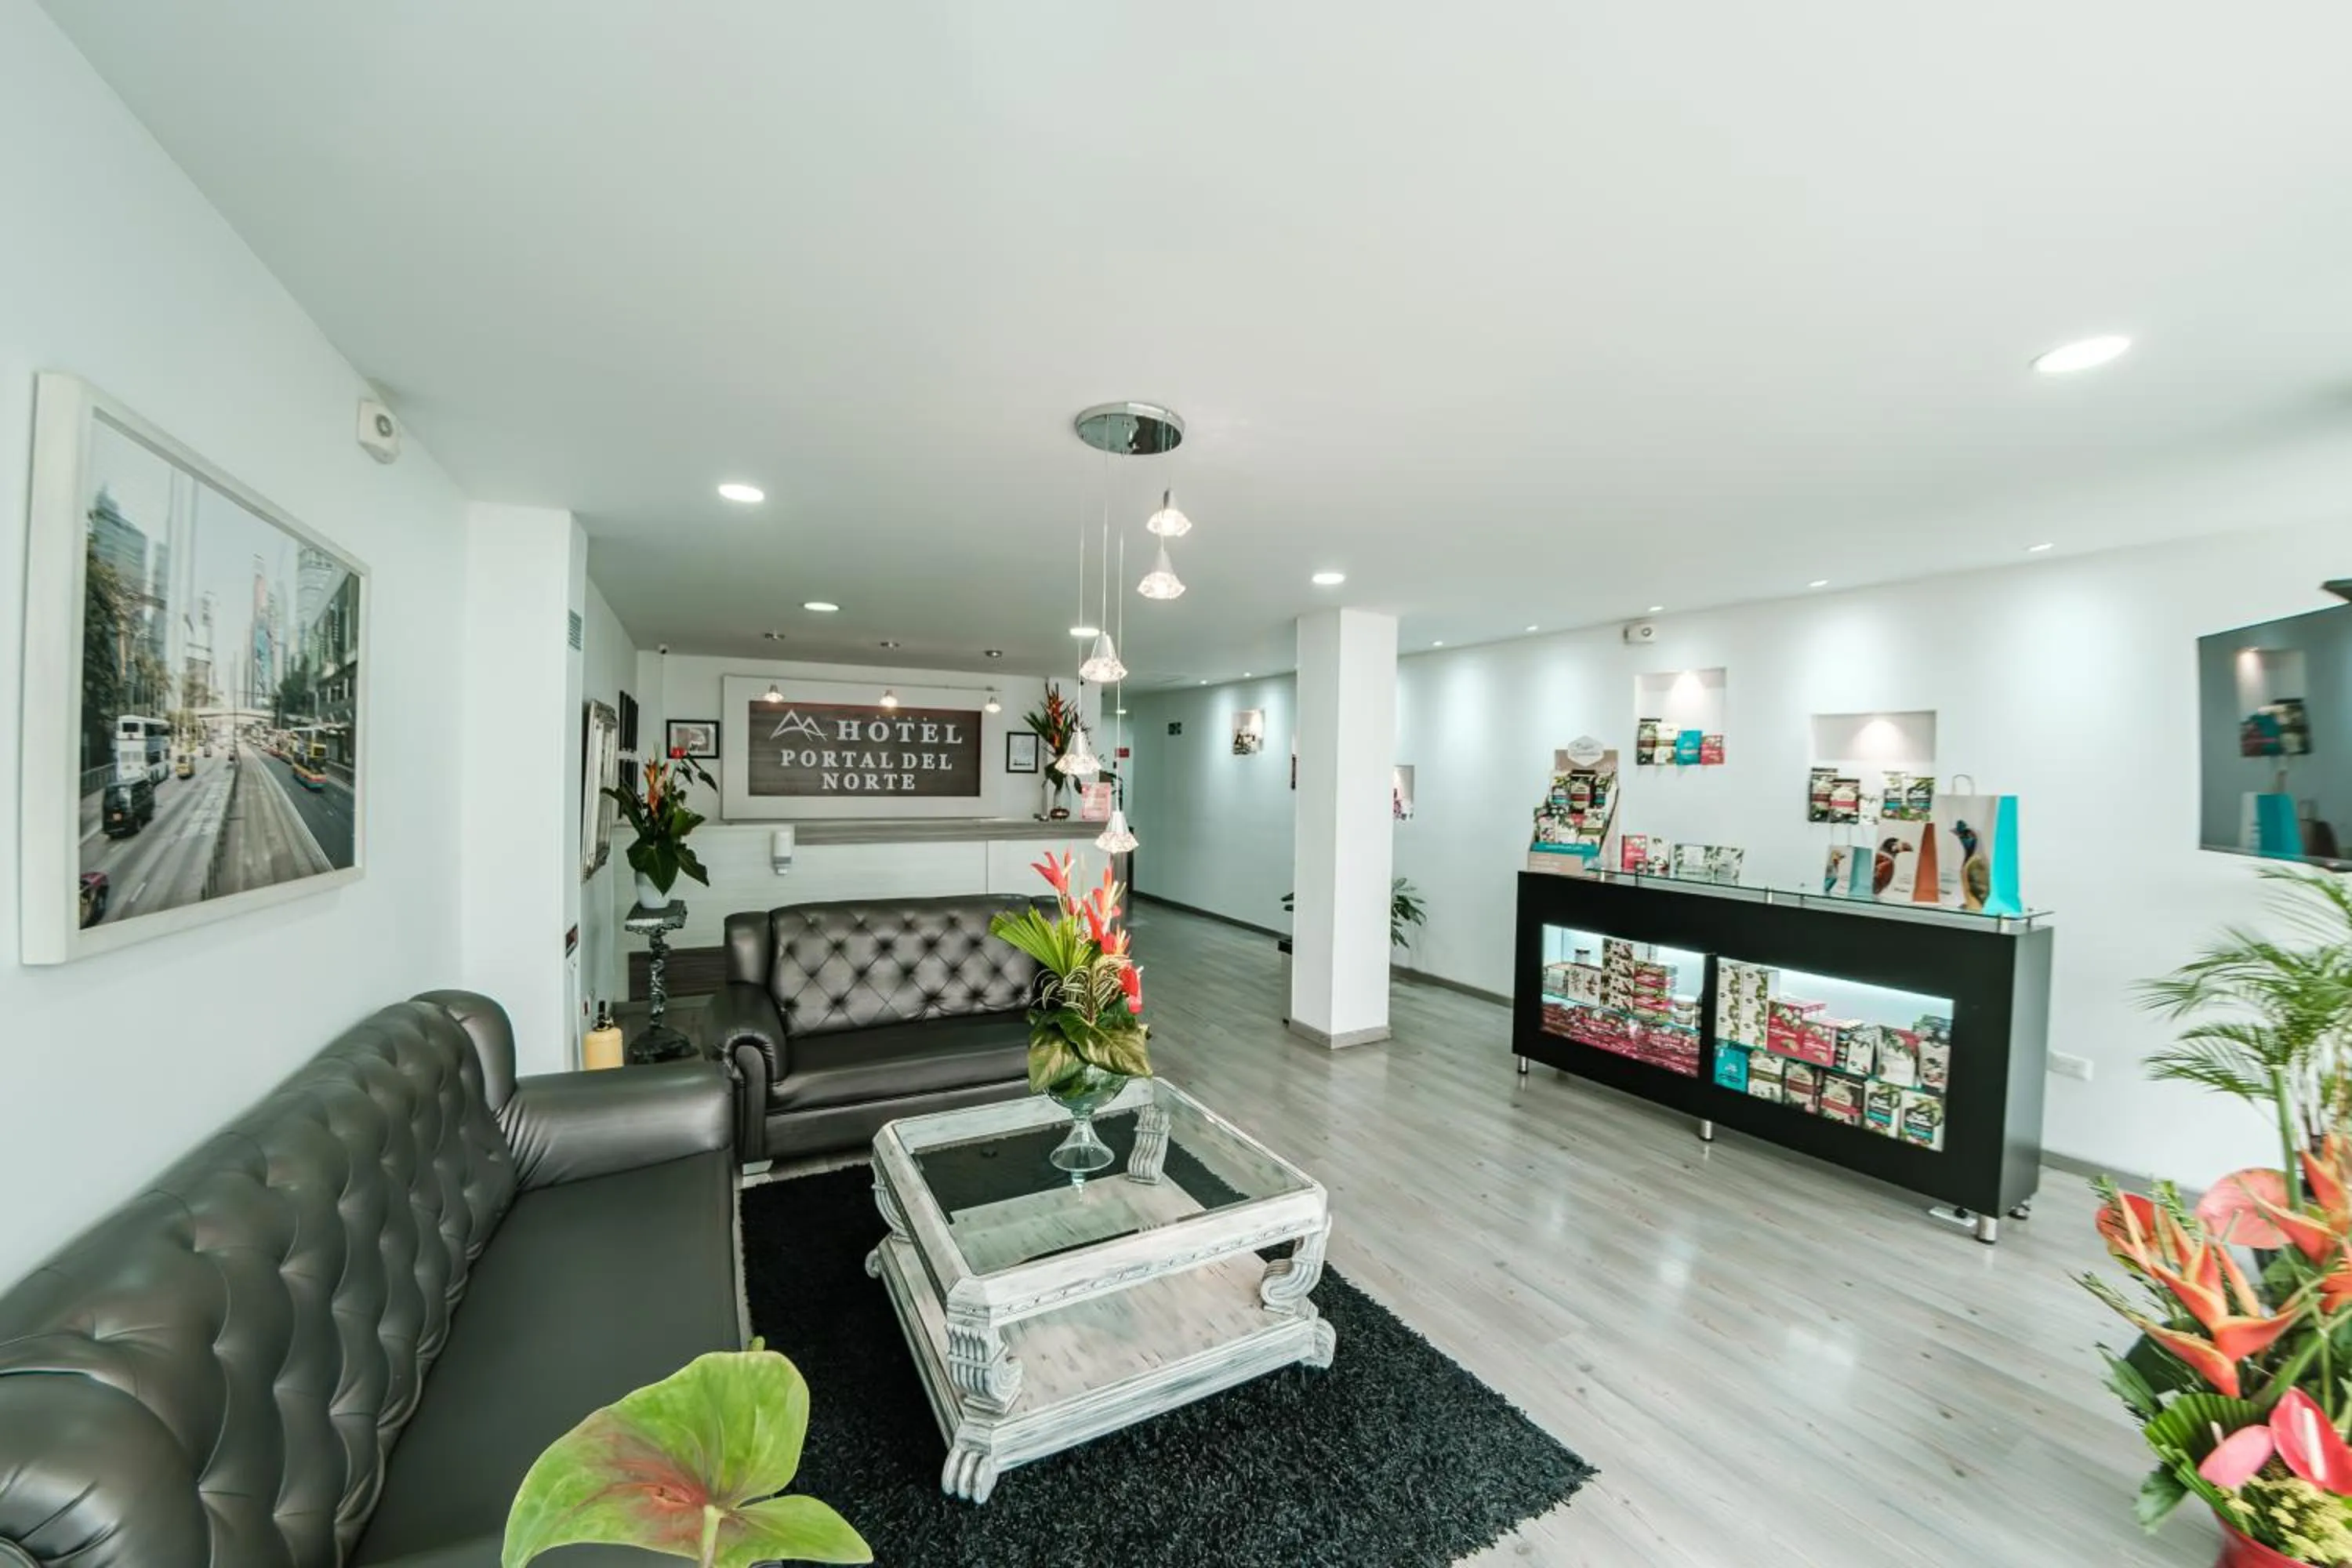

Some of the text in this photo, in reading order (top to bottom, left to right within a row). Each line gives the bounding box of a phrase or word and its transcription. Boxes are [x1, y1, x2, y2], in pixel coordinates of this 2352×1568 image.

[837, 720, 963, 744] HOTEL
[781, 750, 953, 770] PORTAL DEL
[822, 773, 916, 789] NORTE
